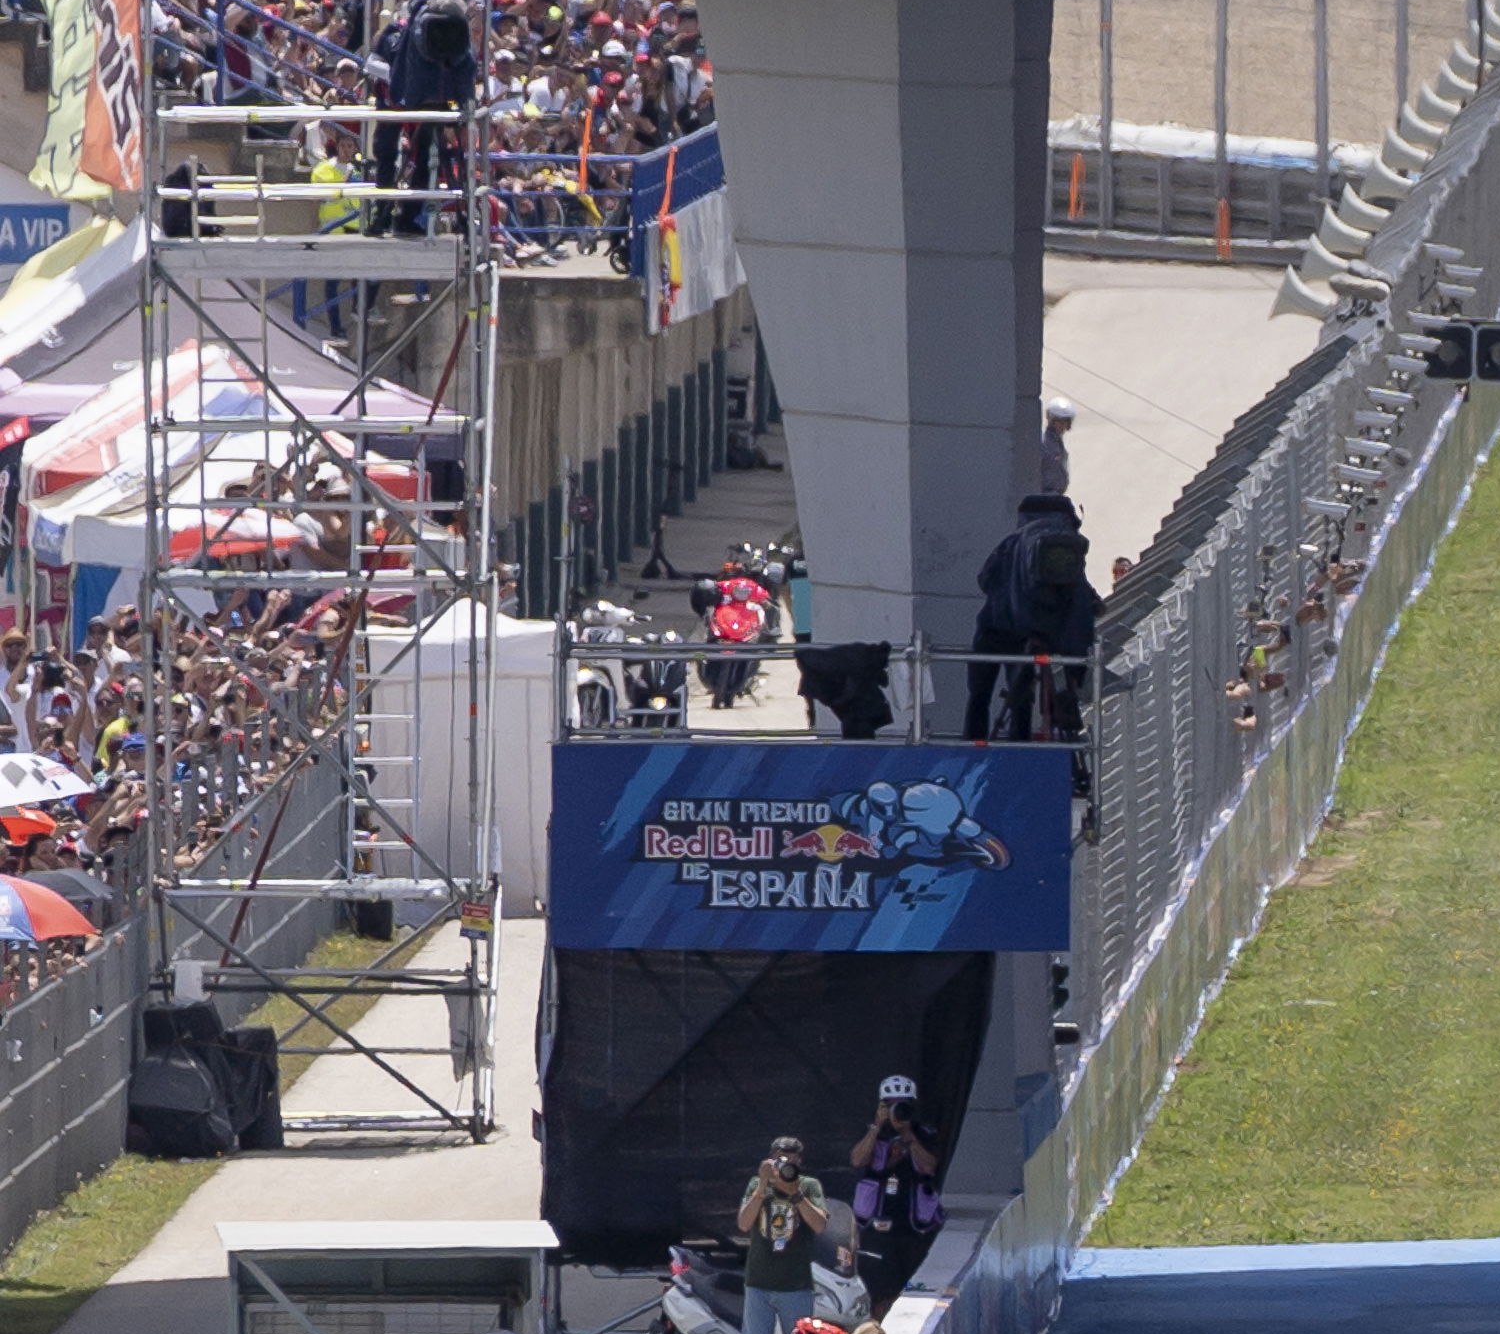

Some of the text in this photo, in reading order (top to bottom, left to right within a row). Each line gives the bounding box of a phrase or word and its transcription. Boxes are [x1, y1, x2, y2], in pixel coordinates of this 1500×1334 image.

[22, 218, 63, 248] VIP
[663, 801, 831, 823] GRAN PREMIO
[645, 825, 773, 859] Red Bull
[682, 863, 872, 907] DE ESPAÑA
